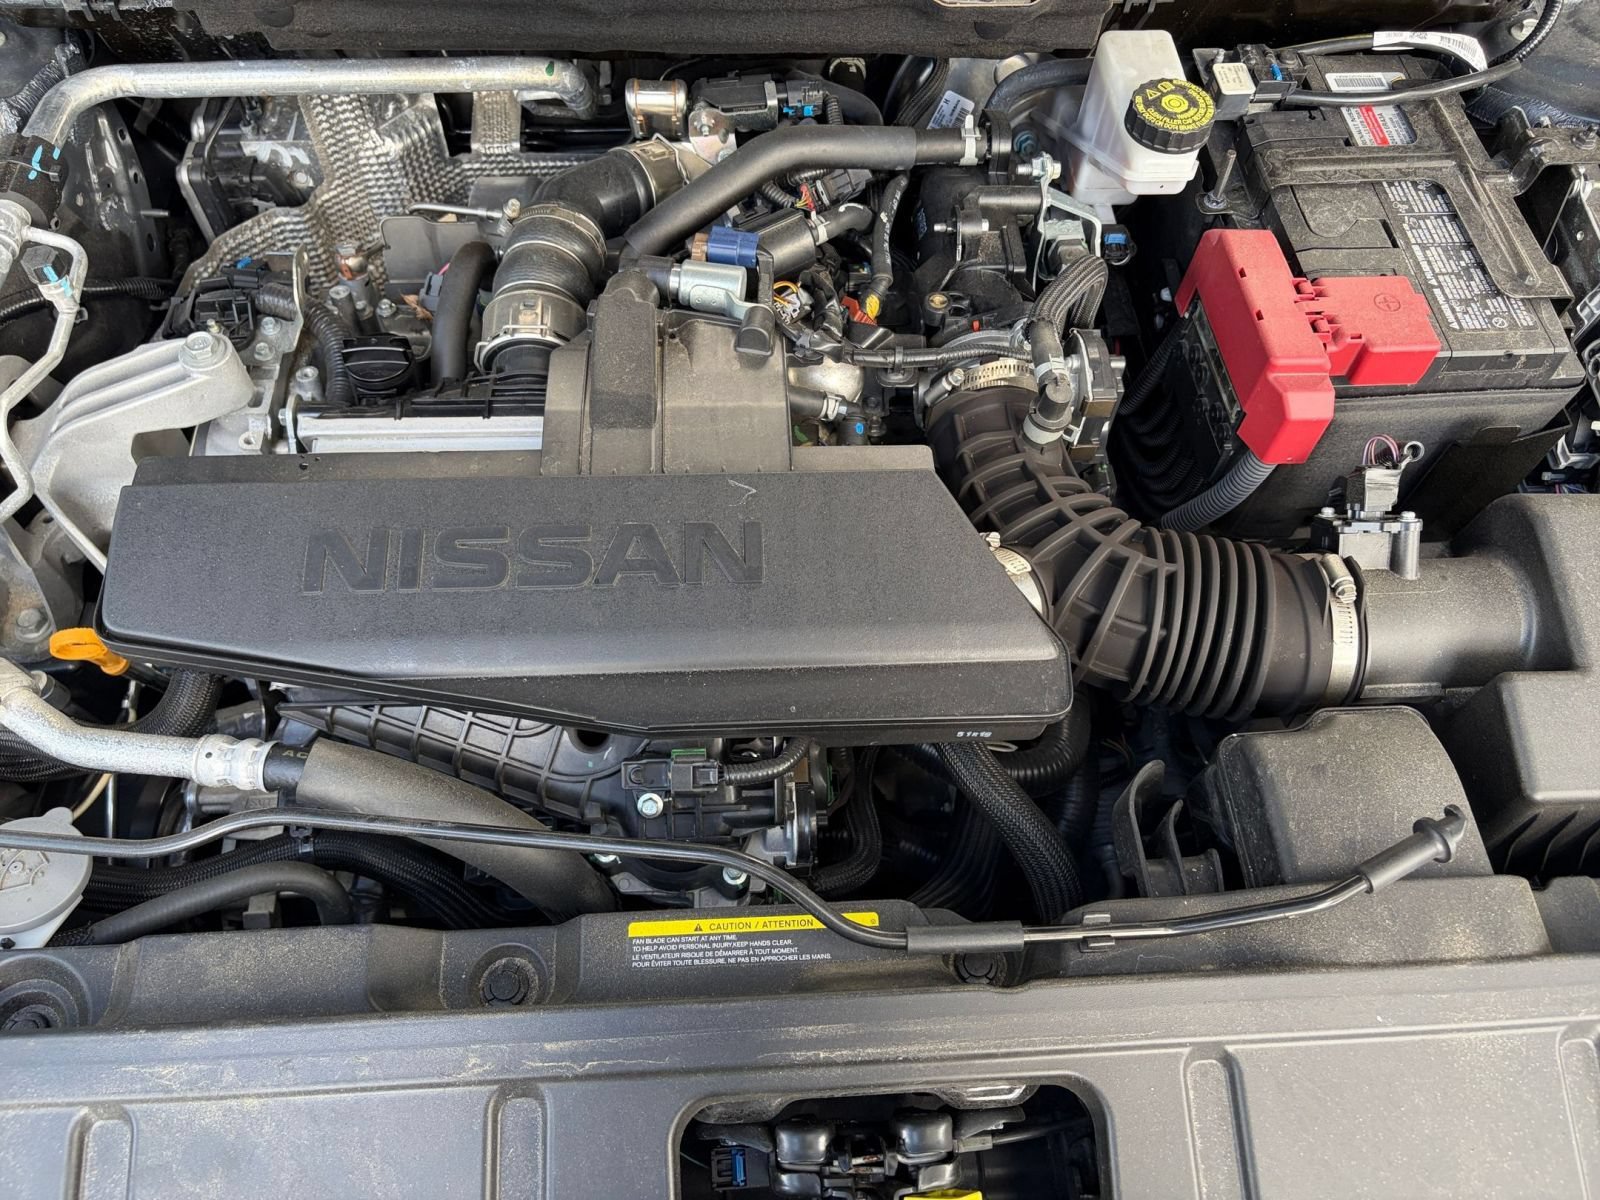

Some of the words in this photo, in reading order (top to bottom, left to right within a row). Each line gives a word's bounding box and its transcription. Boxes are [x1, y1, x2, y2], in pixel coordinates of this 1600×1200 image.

[302, 520, 765, 596] NISSAN
[709, 921, 752, 932] CAUTION
[762, 918, 814, 929] ATTENTION
[679, 942, 711, 950] PERSONAL
[772, 938, 793, 946] CLEAR.
[640, 952, 680, 960] VENTILATEUR
[714, 948, 749, 957] DÉMARRER
[771, 946, 799, 954] MOMENT.
[650, 959, 672, 967] ÉVITER
[760, 954, 799, 962] APPROCHER
[811, 952, 832, 960] MAINS.
